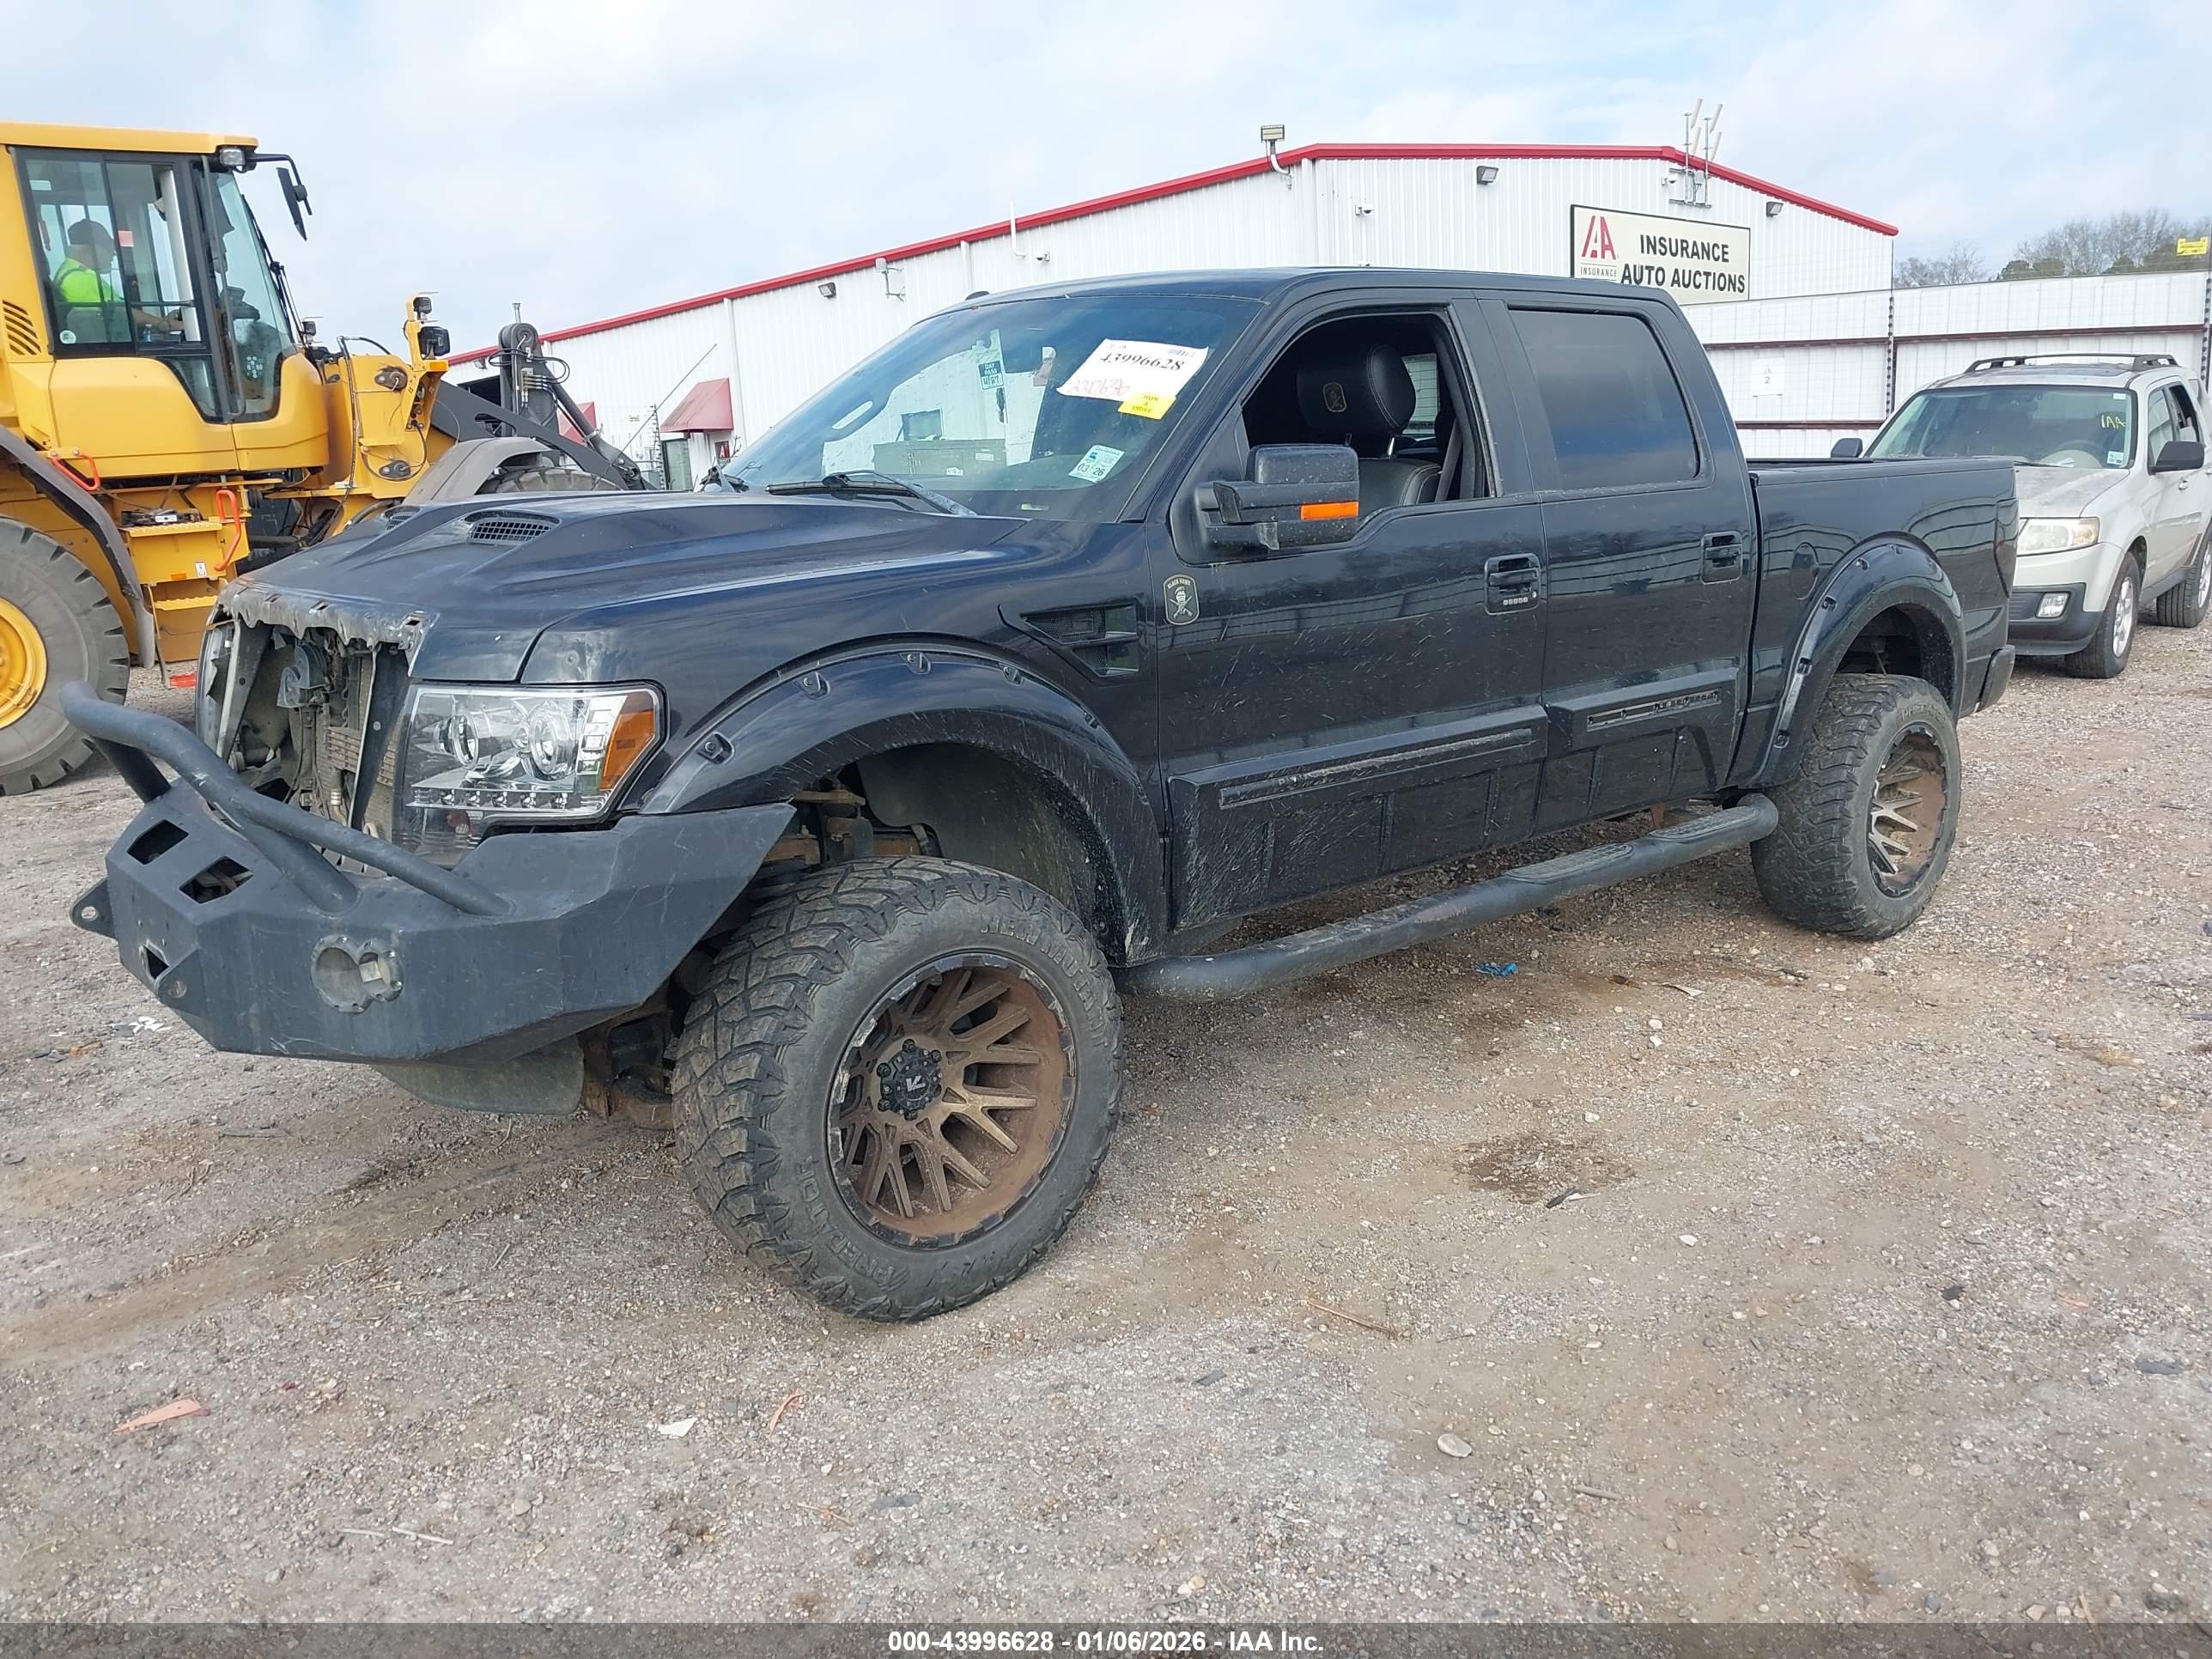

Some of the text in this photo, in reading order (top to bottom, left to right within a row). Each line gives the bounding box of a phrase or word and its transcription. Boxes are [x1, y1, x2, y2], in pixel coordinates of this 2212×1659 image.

[1640, 234, 1729, 263] INSURANCE
[1580, 266, 1618, 277] INSURANCE
[1621, 264, 1745, 294] AUTO AUCTIONS
[1100, 353, 1185, 371] 43996628
[2100, 415, 2125, 428] IAA
[1077, 463, 1105, 477] 03 26
